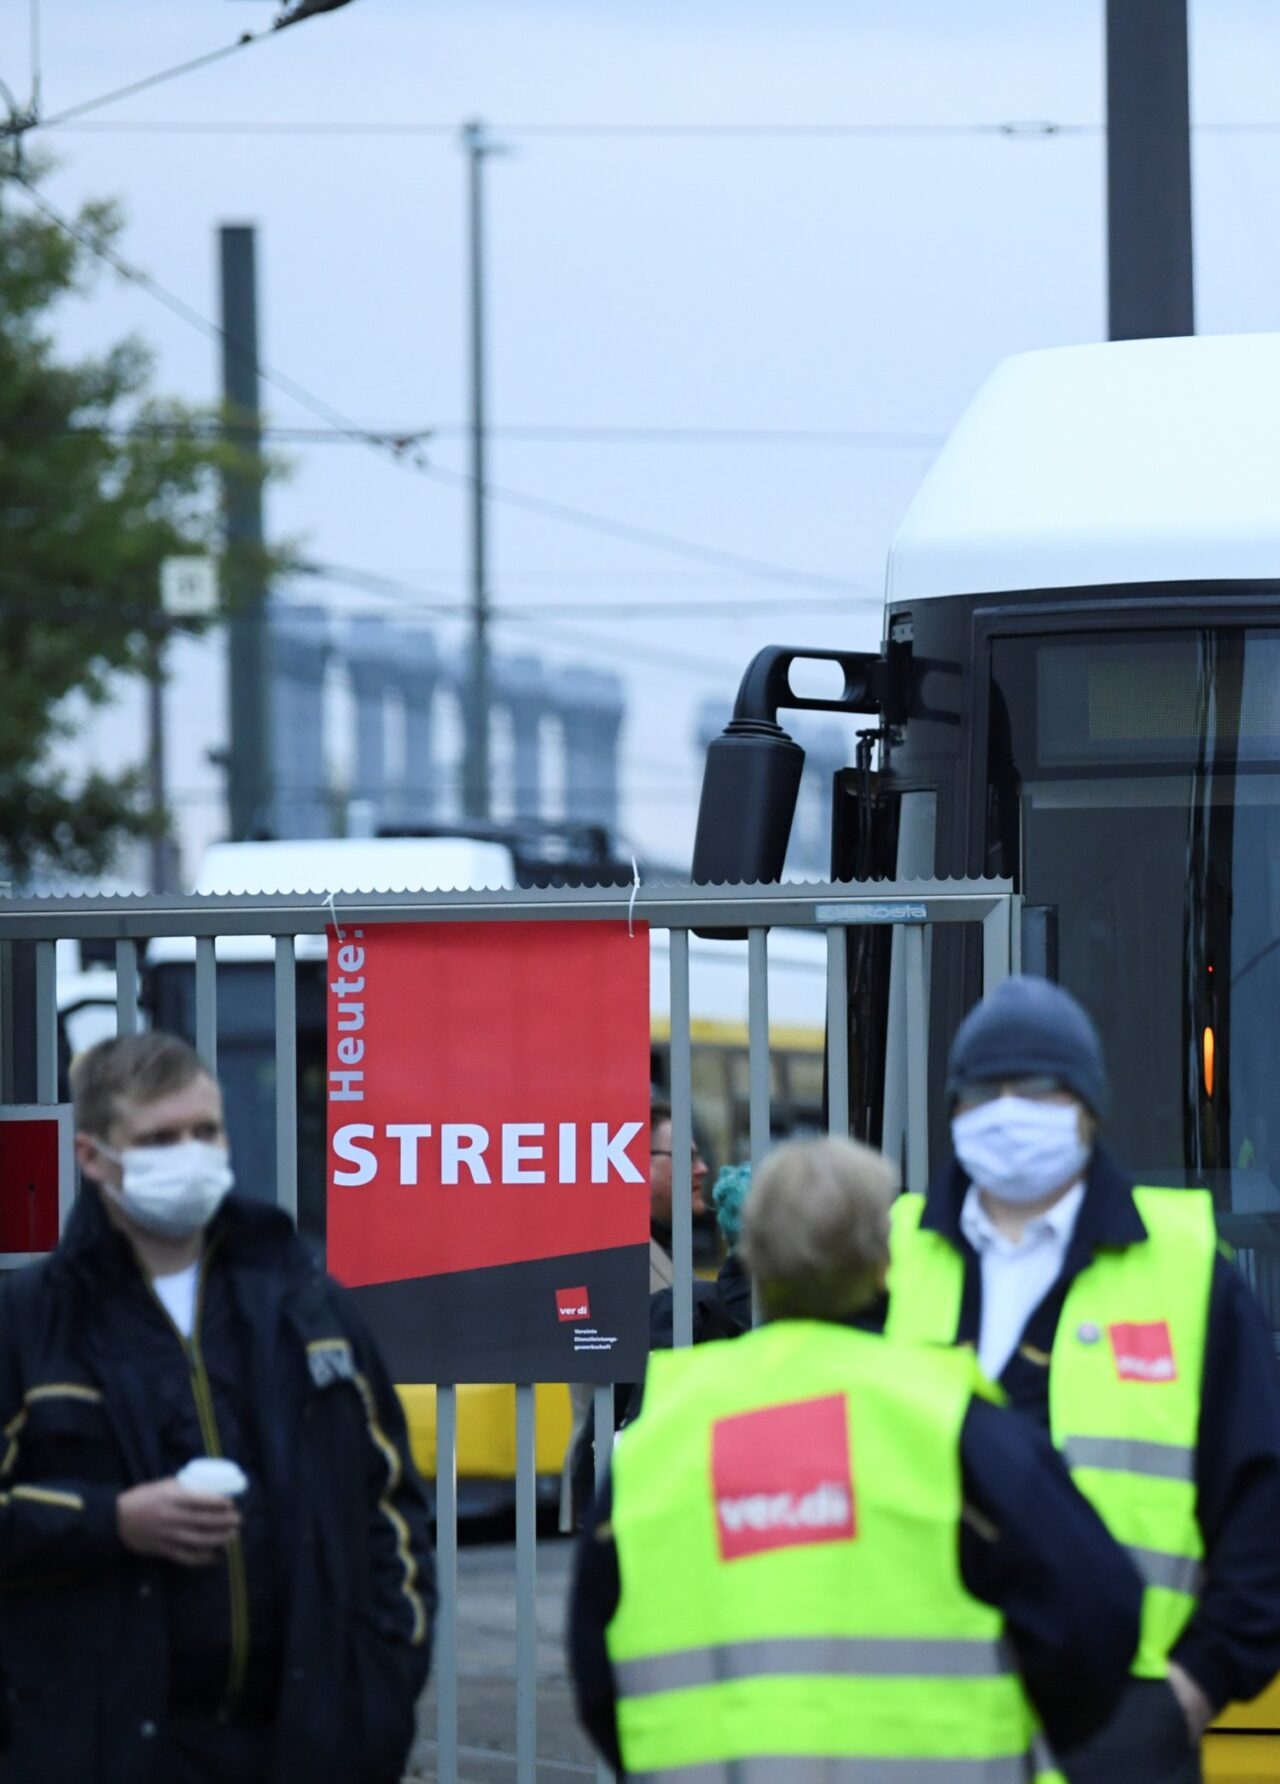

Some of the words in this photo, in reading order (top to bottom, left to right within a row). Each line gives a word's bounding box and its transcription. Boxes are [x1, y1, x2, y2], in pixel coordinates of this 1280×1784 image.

[329, 929, 364, 1101] Heute:
[332, 1122, 646, 1187] STREIK
[718, 1483, 848, 1532] ver.di
